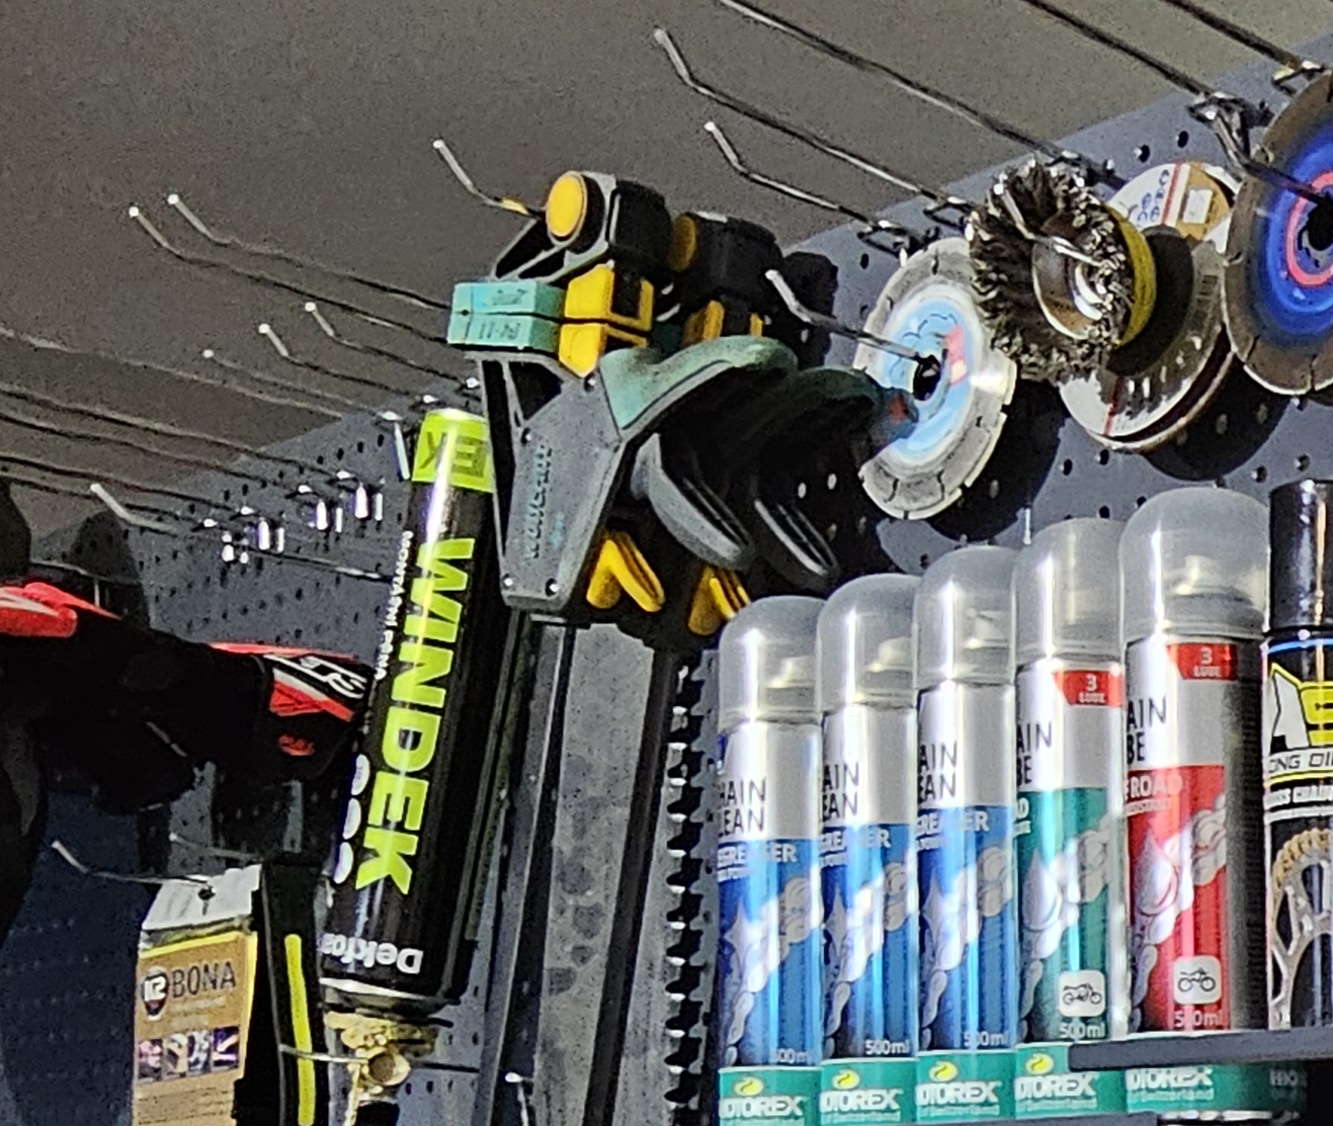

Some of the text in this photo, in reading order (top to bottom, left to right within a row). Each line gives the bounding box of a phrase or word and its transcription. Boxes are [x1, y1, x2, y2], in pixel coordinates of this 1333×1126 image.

[1200, 646, 1213, 665] 3
[1086, 673, 1098, 692] 3
[355, 535, 474, 897] WINDEK
[171, 960, 237, 998] BONA
[1059, 1021, 1106, 1039] 500ml
[865, 1038, 910, 1055] 500ml
[915, 1080, 1001, 1107] OTOREX
[1014, 1071, 1097, 1099] OTOREX
[719, 1095, 804, 1119] OTOREX
[820, 1088, 902, 1113] OTOREX
